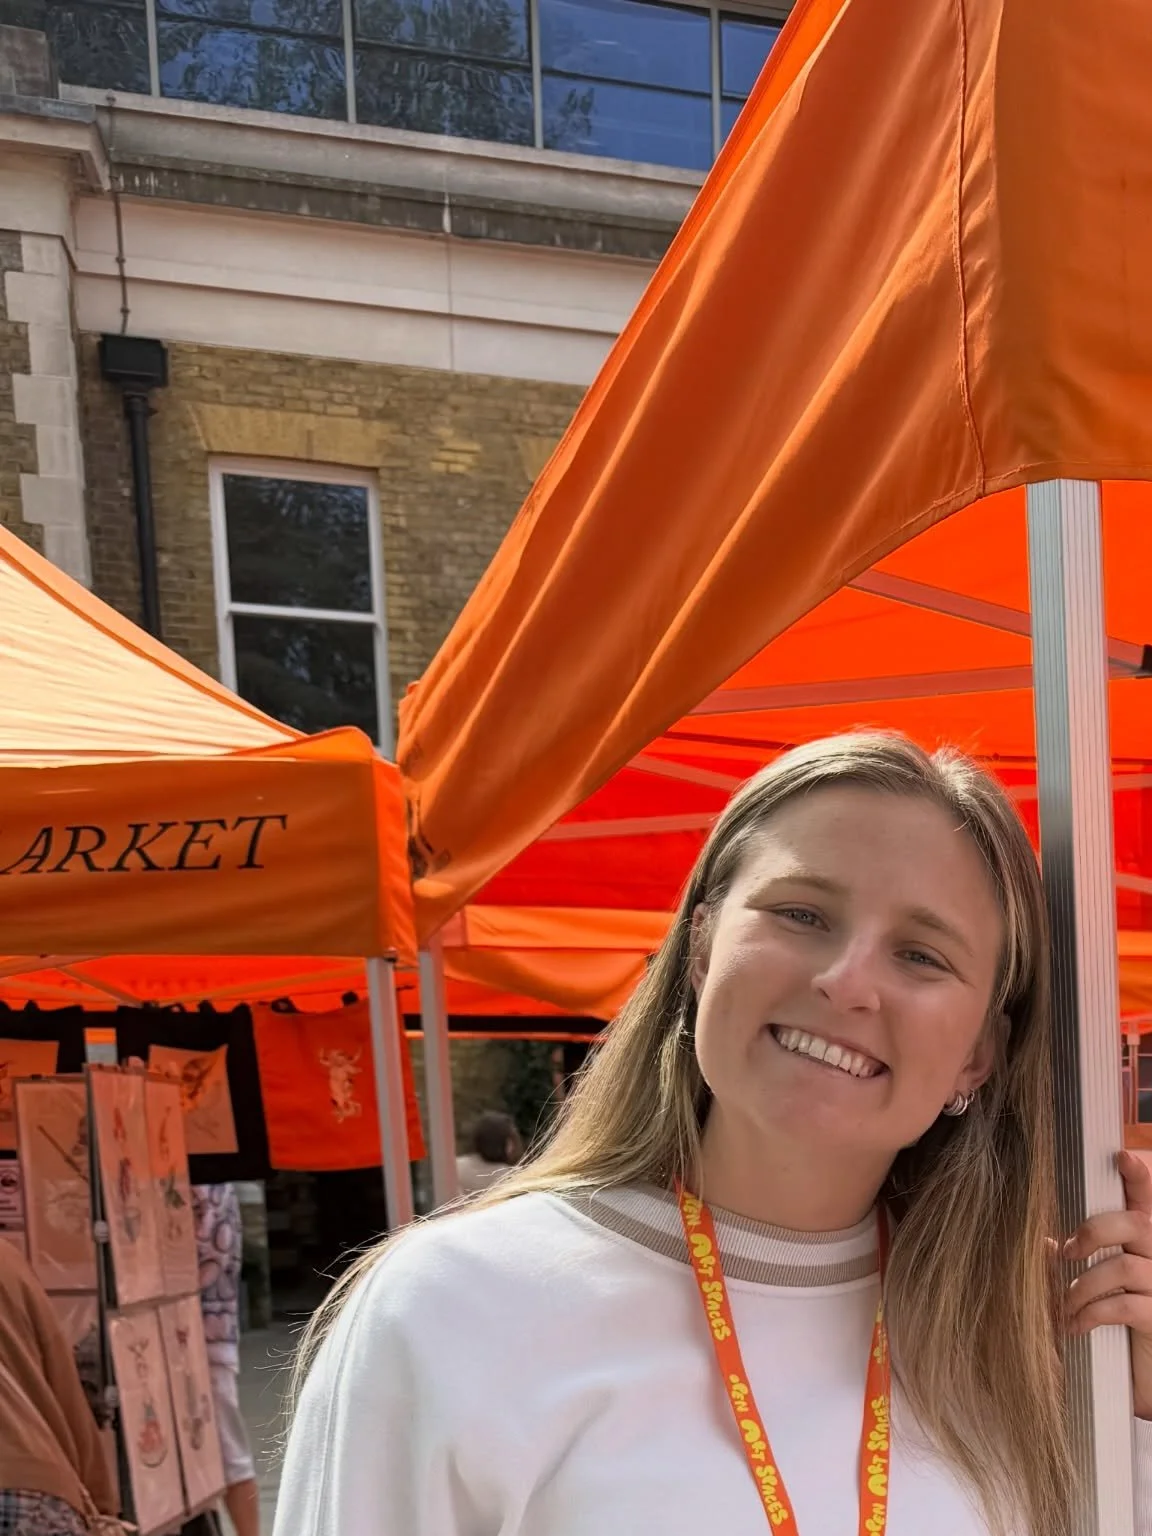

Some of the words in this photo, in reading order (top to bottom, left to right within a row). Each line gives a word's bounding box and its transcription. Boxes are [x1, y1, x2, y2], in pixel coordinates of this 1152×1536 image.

[0, 814, 288, 875] ARKET
[690, 1233, 716, 1278] ART
[701, 1281, 732, 1341] SPACES
[740, 1419, 766, 1462] ART
[755, 1464, 789, 1525] SPACES
[867, 1455, 888, 1497] ART
